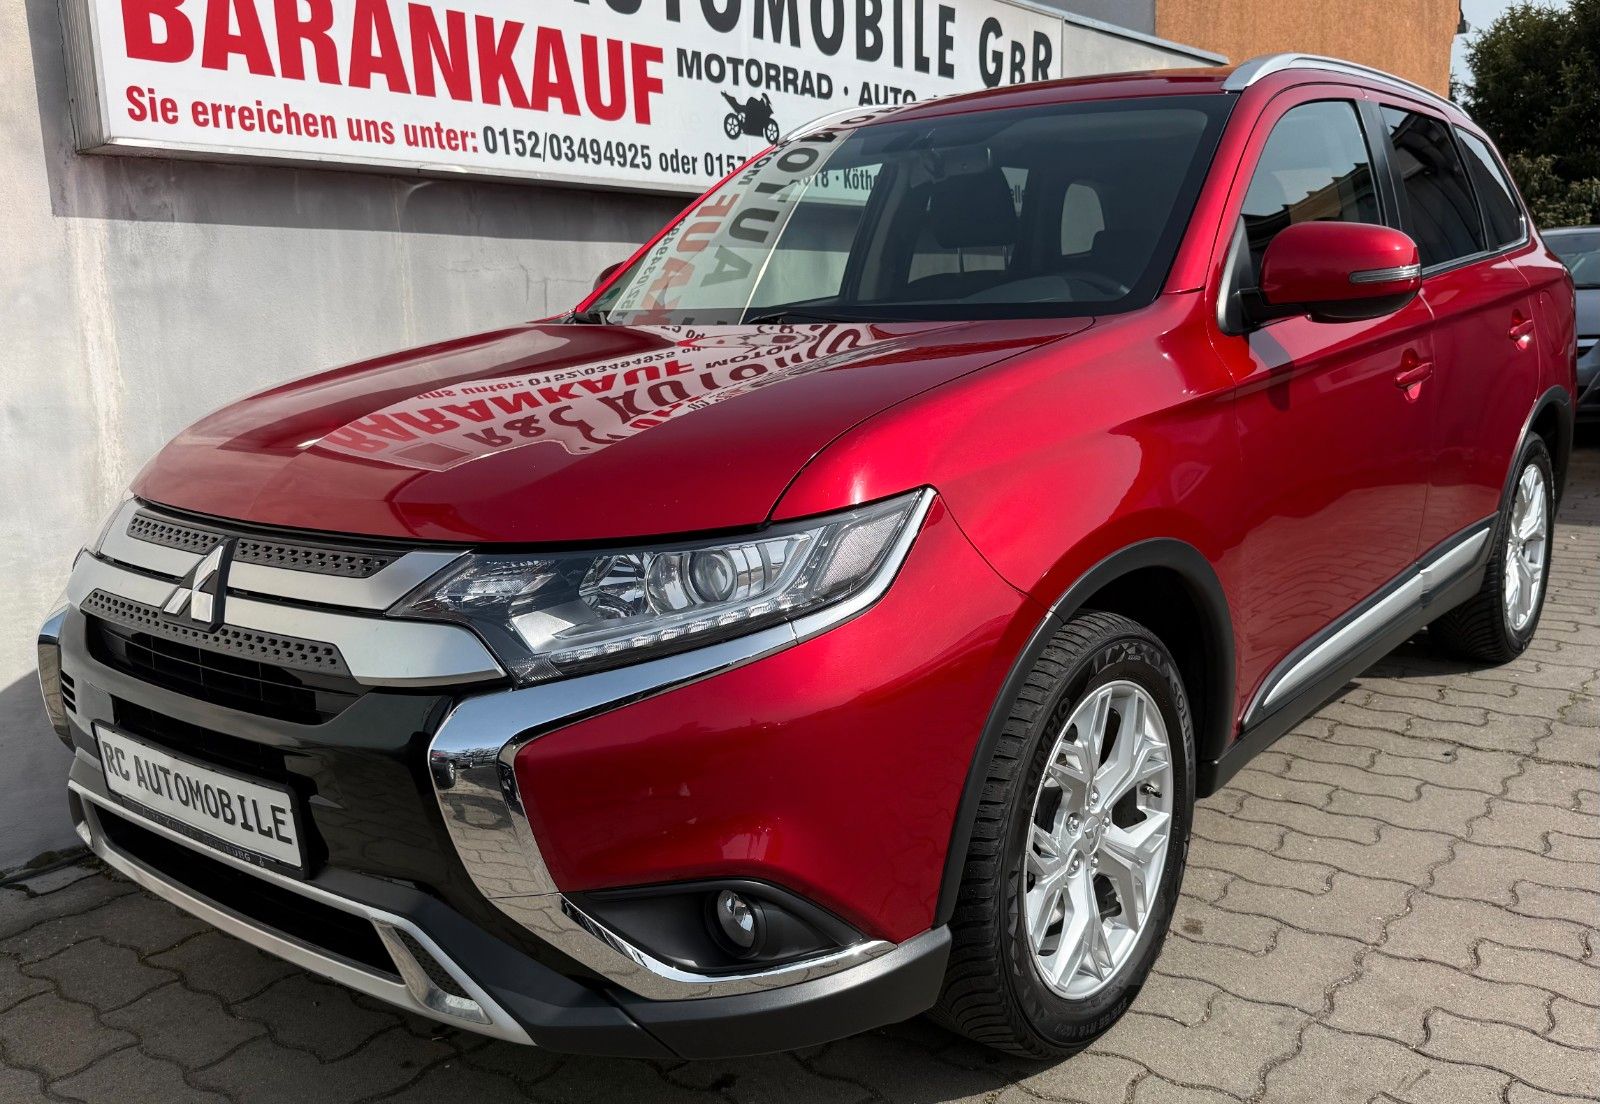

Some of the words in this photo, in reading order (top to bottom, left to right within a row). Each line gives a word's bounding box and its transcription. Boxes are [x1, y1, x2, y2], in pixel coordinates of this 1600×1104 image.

[121, 0, 664, 125] BARANKAUF
[676, 47, 833, 100] MOTORRAD
[858, 81, 917, 107] AUTO
[126, 85, 179, 125] Sie
[191, 100, 337, 140] erreichen
[347, 118, 397, 146] uns
[403, 122, 479, 153] unter:
[483, 125, 653, 171] 0152/03494925
[659, 148, 700, 176] oder
[102, 740, 131, 782] RC
[133, 754, 294, 845] AUTOMOBILE
